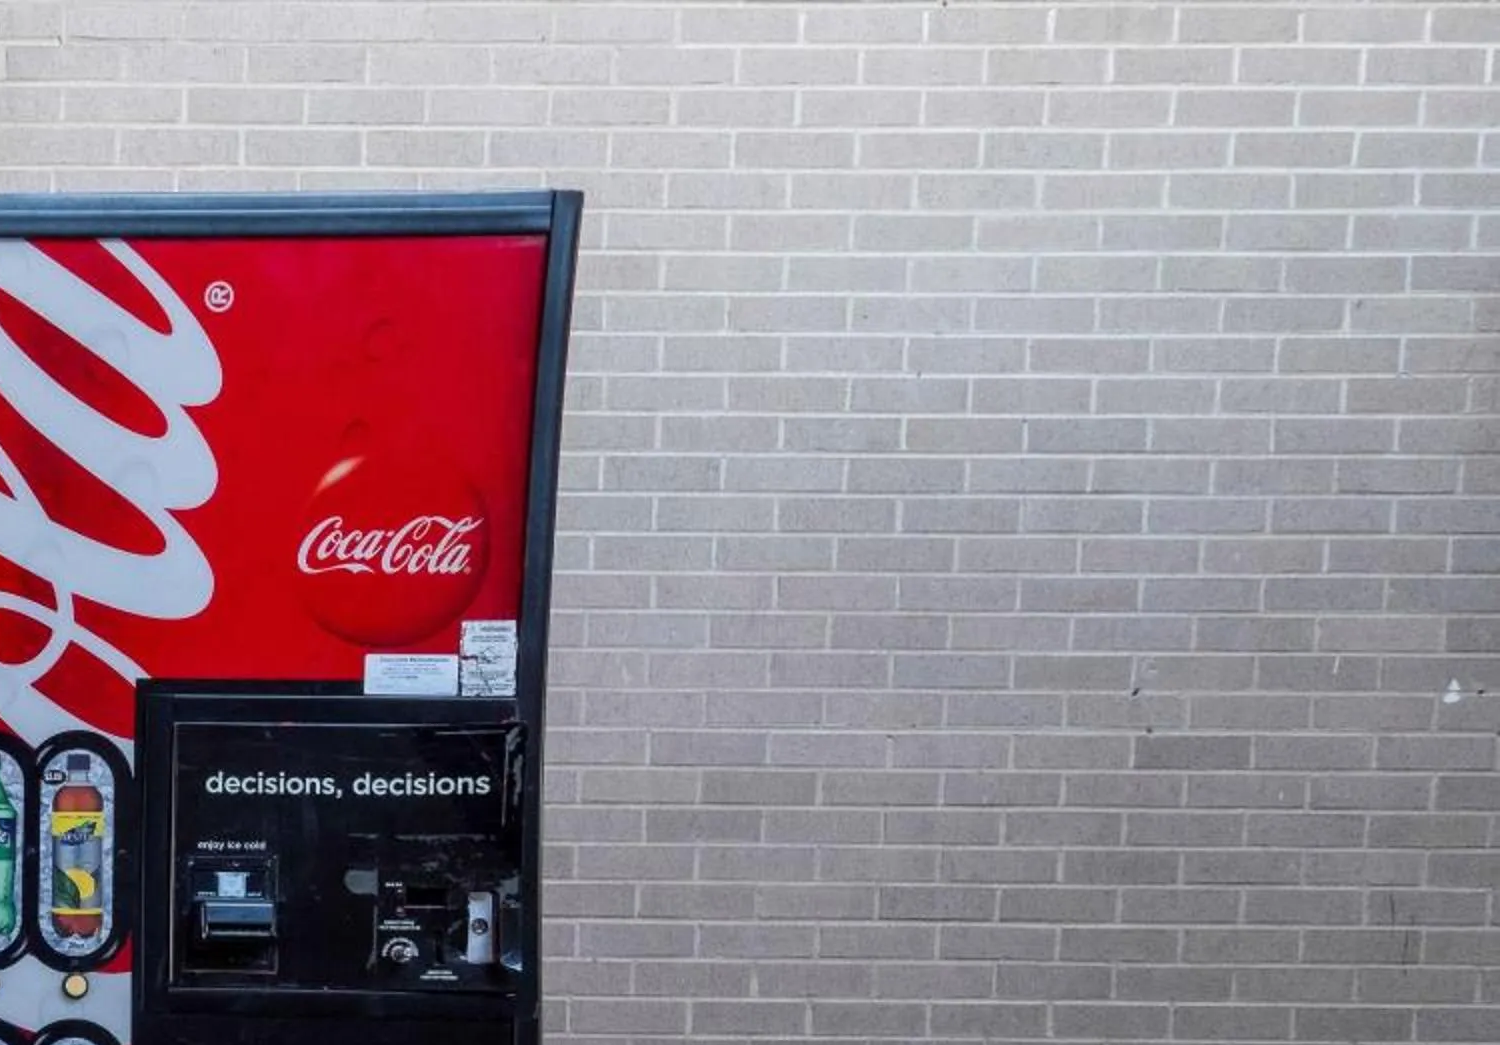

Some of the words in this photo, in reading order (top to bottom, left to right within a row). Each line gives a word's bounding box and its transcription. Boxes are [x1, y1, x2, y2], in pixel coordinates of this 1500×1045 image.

[297, 515, 484, 575] Coca-Cola
[205, 771, 343, 799] decisions,
[352, 772, 491, 795] decisions
[197, 840, 225, 851] enjoy
